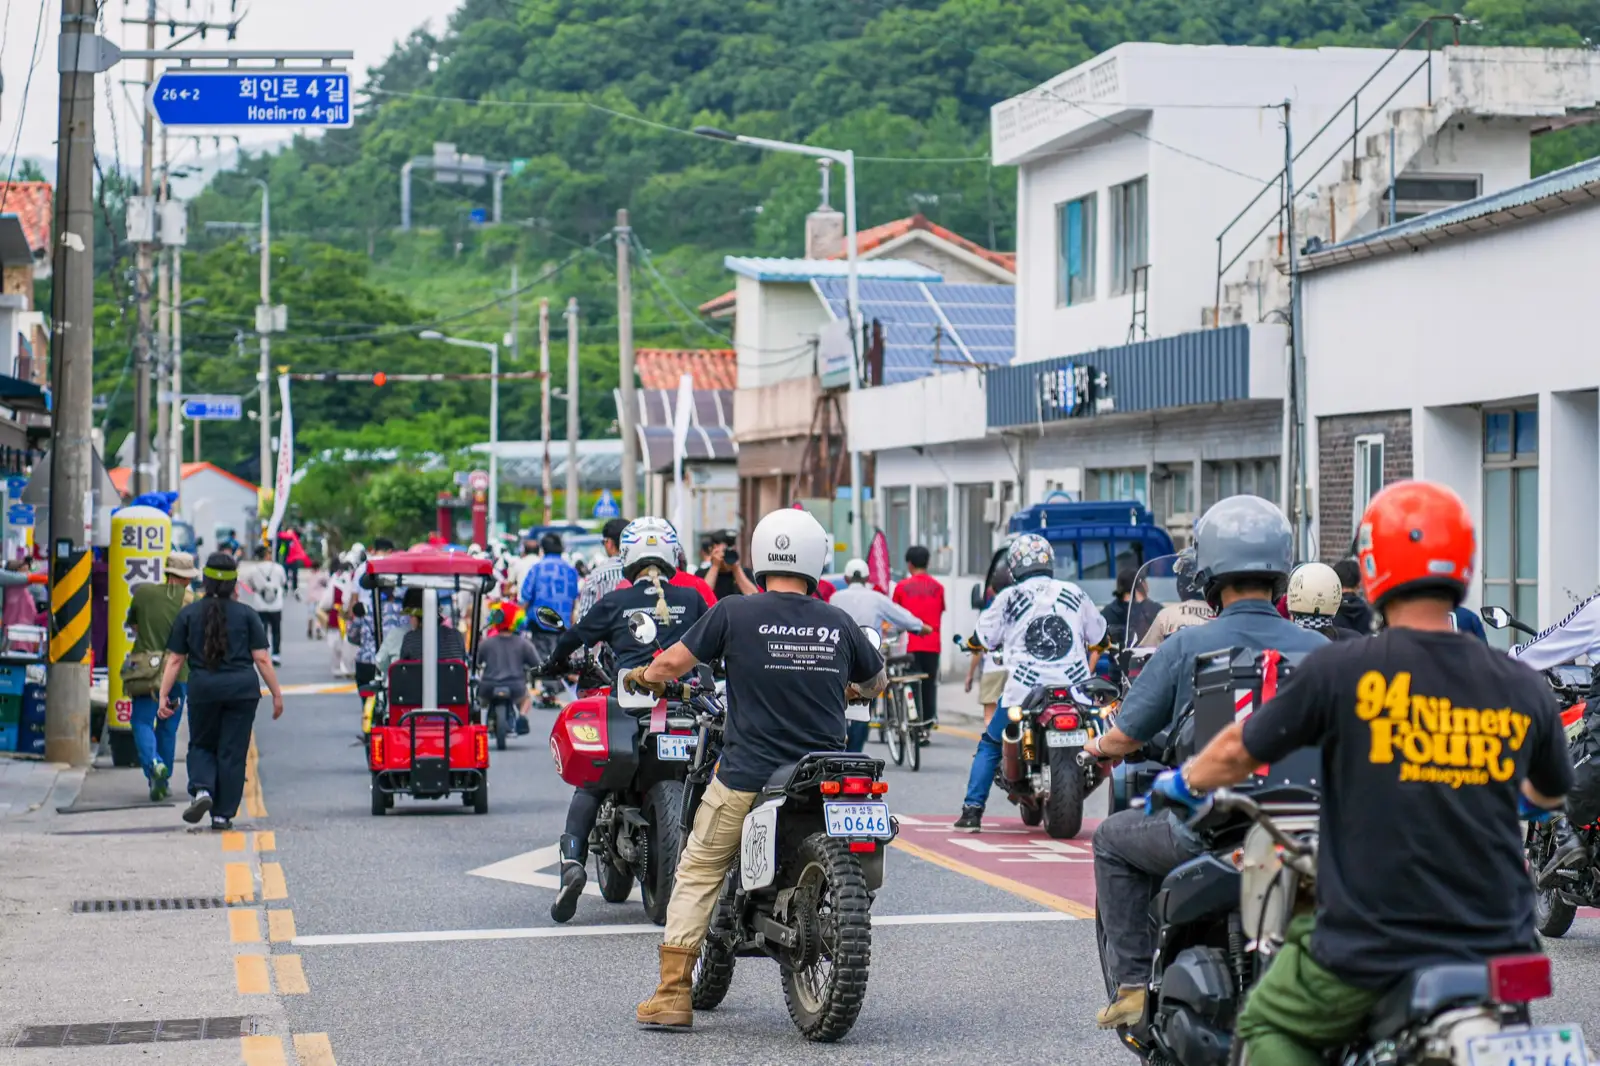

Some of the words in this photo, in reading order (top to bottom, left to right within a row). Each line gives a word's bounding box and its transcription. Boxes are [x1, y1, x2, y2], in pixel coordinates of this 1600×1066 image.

[162, 88, 178, 101] 26
[192, 88, 200, 101] 2
[239, 78, 300, 102] 회인로
[305, 79, 319, 98] 4
[325, 78, 345, 102] 길
[248, 105, 306, 121] Hoein-ro
[311, 105, 344, 123] 4-gil
[121, 525, 164, 550] 회인
[758, 624, 815, 636] GARAGE
[817, 626, 840, 645] 94
[1355, 670, 1411, 721] 94
[1412, 694, 1532, 751] Ninety
[844, 816, 885, 831] 0646
